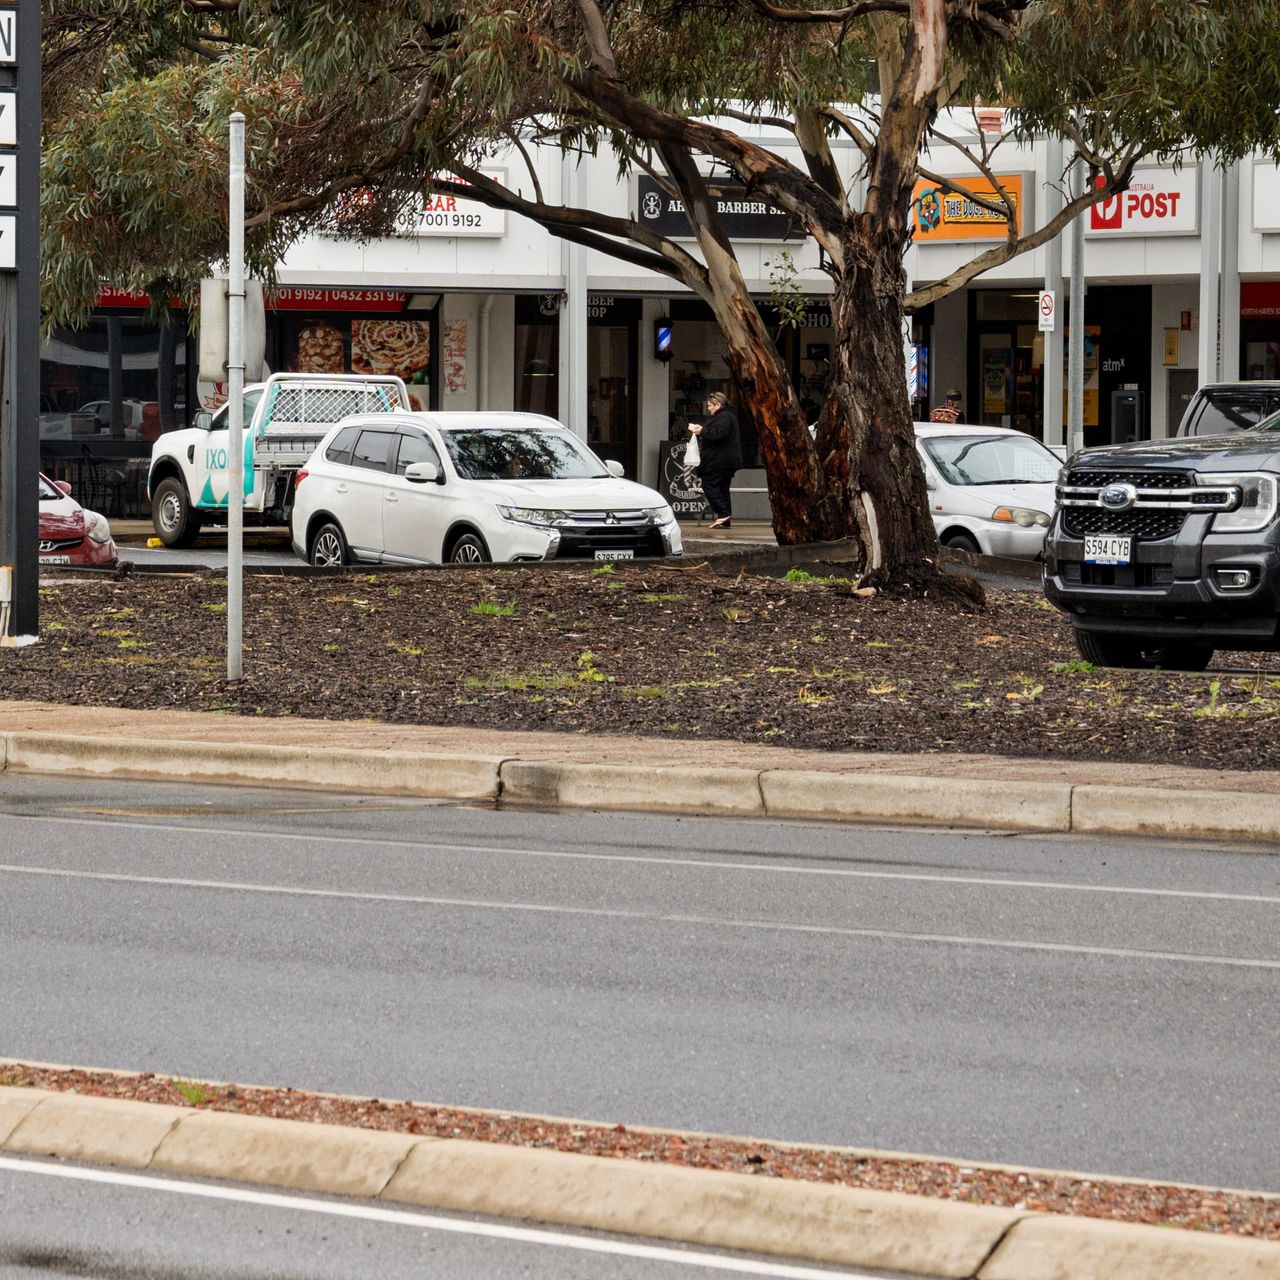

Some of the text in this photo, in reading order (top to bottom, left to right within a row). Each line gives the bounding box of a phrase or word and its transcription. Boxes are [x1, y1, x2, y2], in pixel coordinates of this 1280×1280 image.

[717, 201, 767, 214] BARBER
[945, 200, 961, 217] THE
[1127, 192, 1180, 219] POST
[419, 214, 449, 226] 7001
[452, 214, 482, 227] 9192
[295, 288, 322, 300] 9192
[332, 290, 362, 302] 0432
[365, 290, 384, 301] 331
[587, 297, 614, 306] BER
[587, 307, 607, 317] OP
[798, 313, 832, 328] SHO
[206, 448, 229, 470] IXO
[672, 501, 706, 512] OPEN
[1085, 539, 1129, 556] S594 CYB
